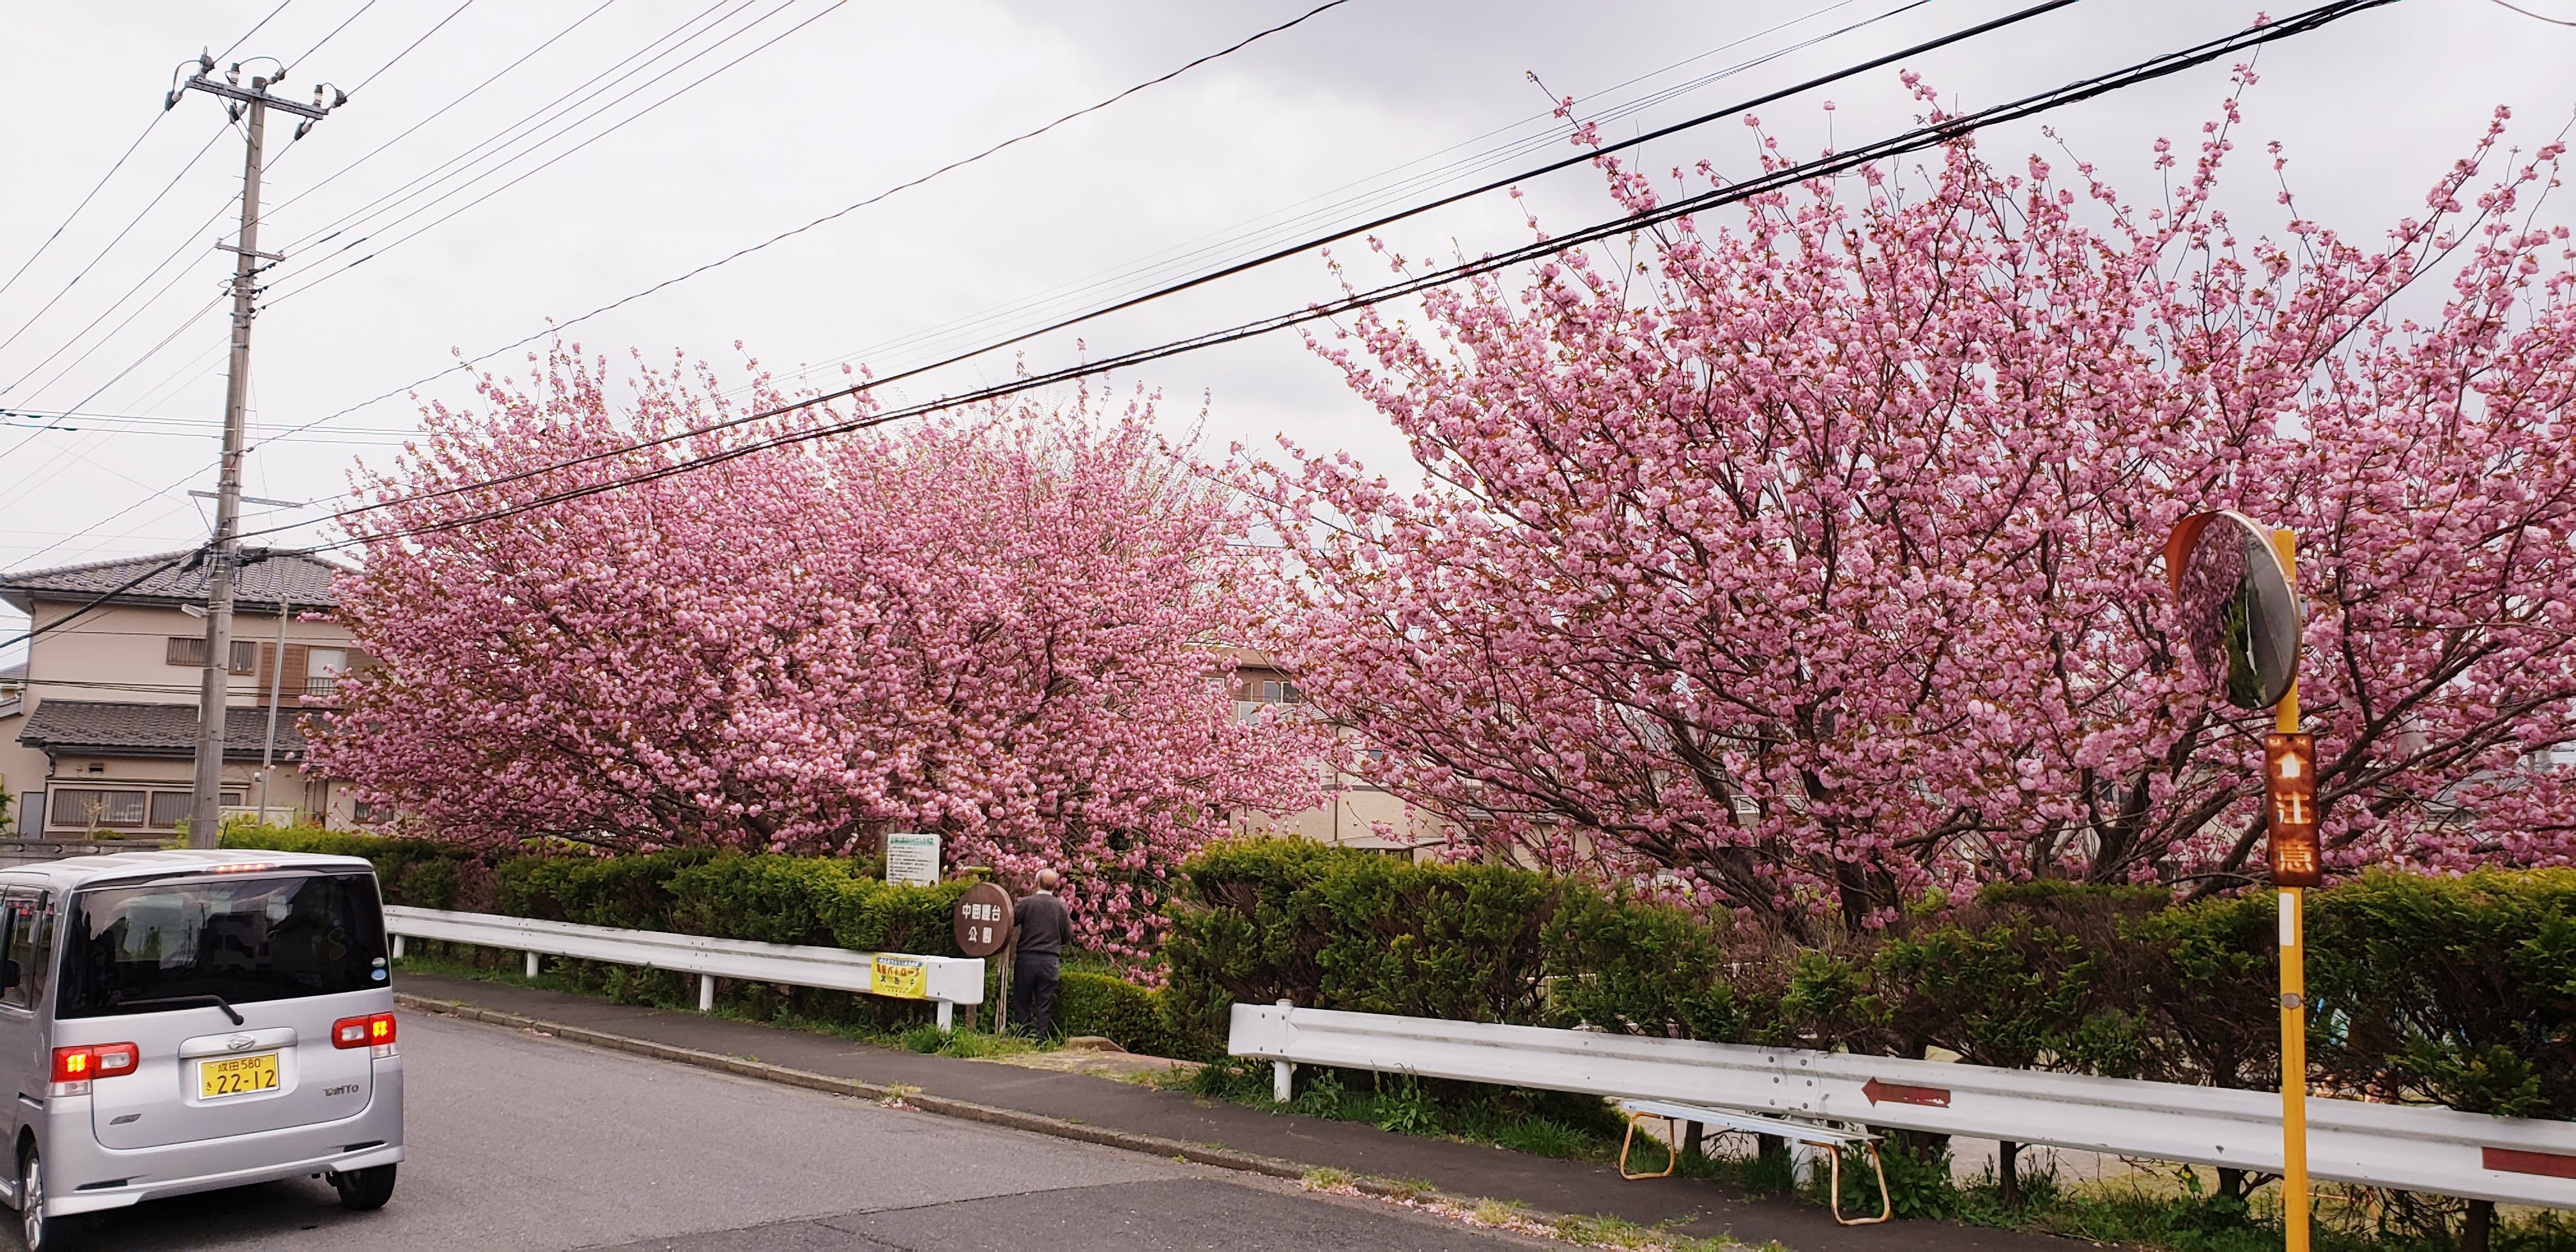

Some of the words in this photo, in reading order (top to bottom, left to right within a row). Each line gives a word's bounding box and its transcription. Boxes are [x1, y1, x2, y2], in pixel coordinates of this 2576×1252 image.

[2274, 791, 2313, 873] 注意
[968, 926, 992, 943] 公園
[218, 1062, 239, 1073] 成田
[241, 1058, 261, 1069] 580
[217, 1069, 277, 1095] 22-12
